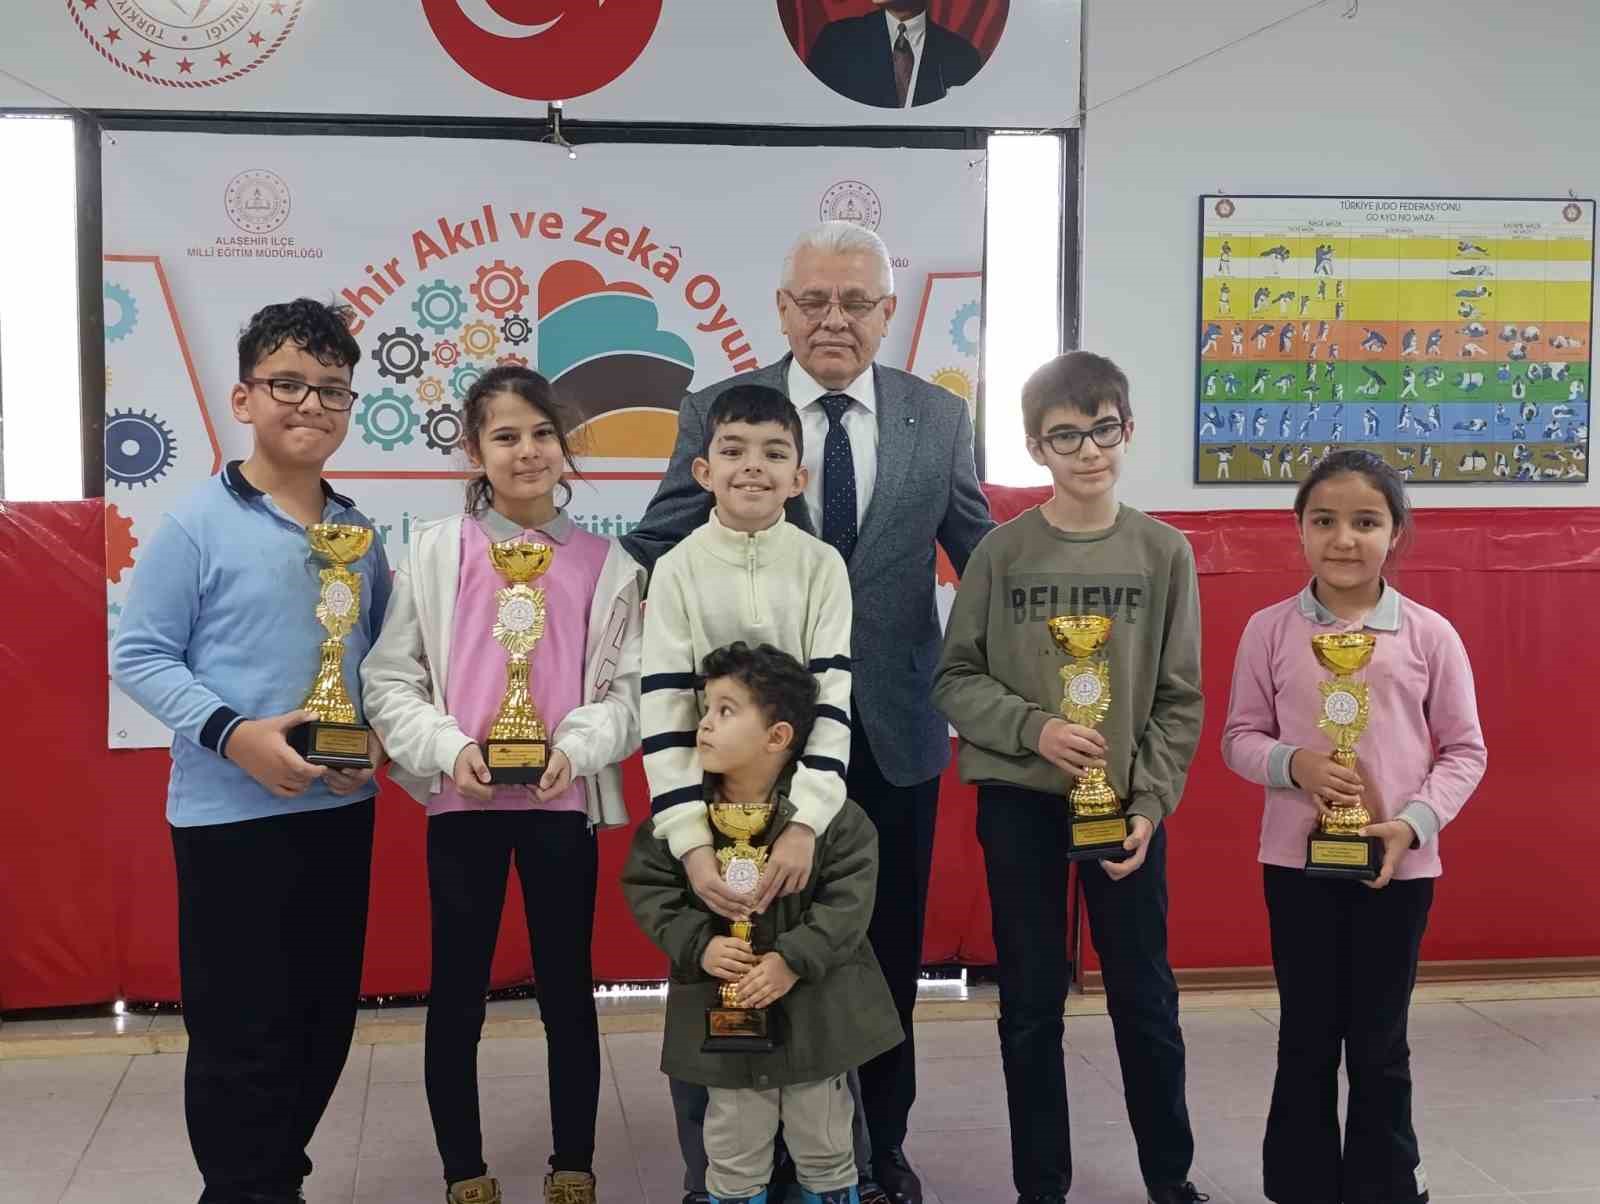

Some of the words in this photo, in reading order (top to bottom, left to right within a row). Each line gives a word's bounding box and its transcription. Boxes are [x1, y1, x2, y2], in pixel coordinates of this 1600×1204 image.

[411, 204, 500, 271] Akıl
[510, 210, 564, 239] ve
[574, 206, 683, 284] Zekâ
[1012, 585, 1142, 624] BELIEVE
